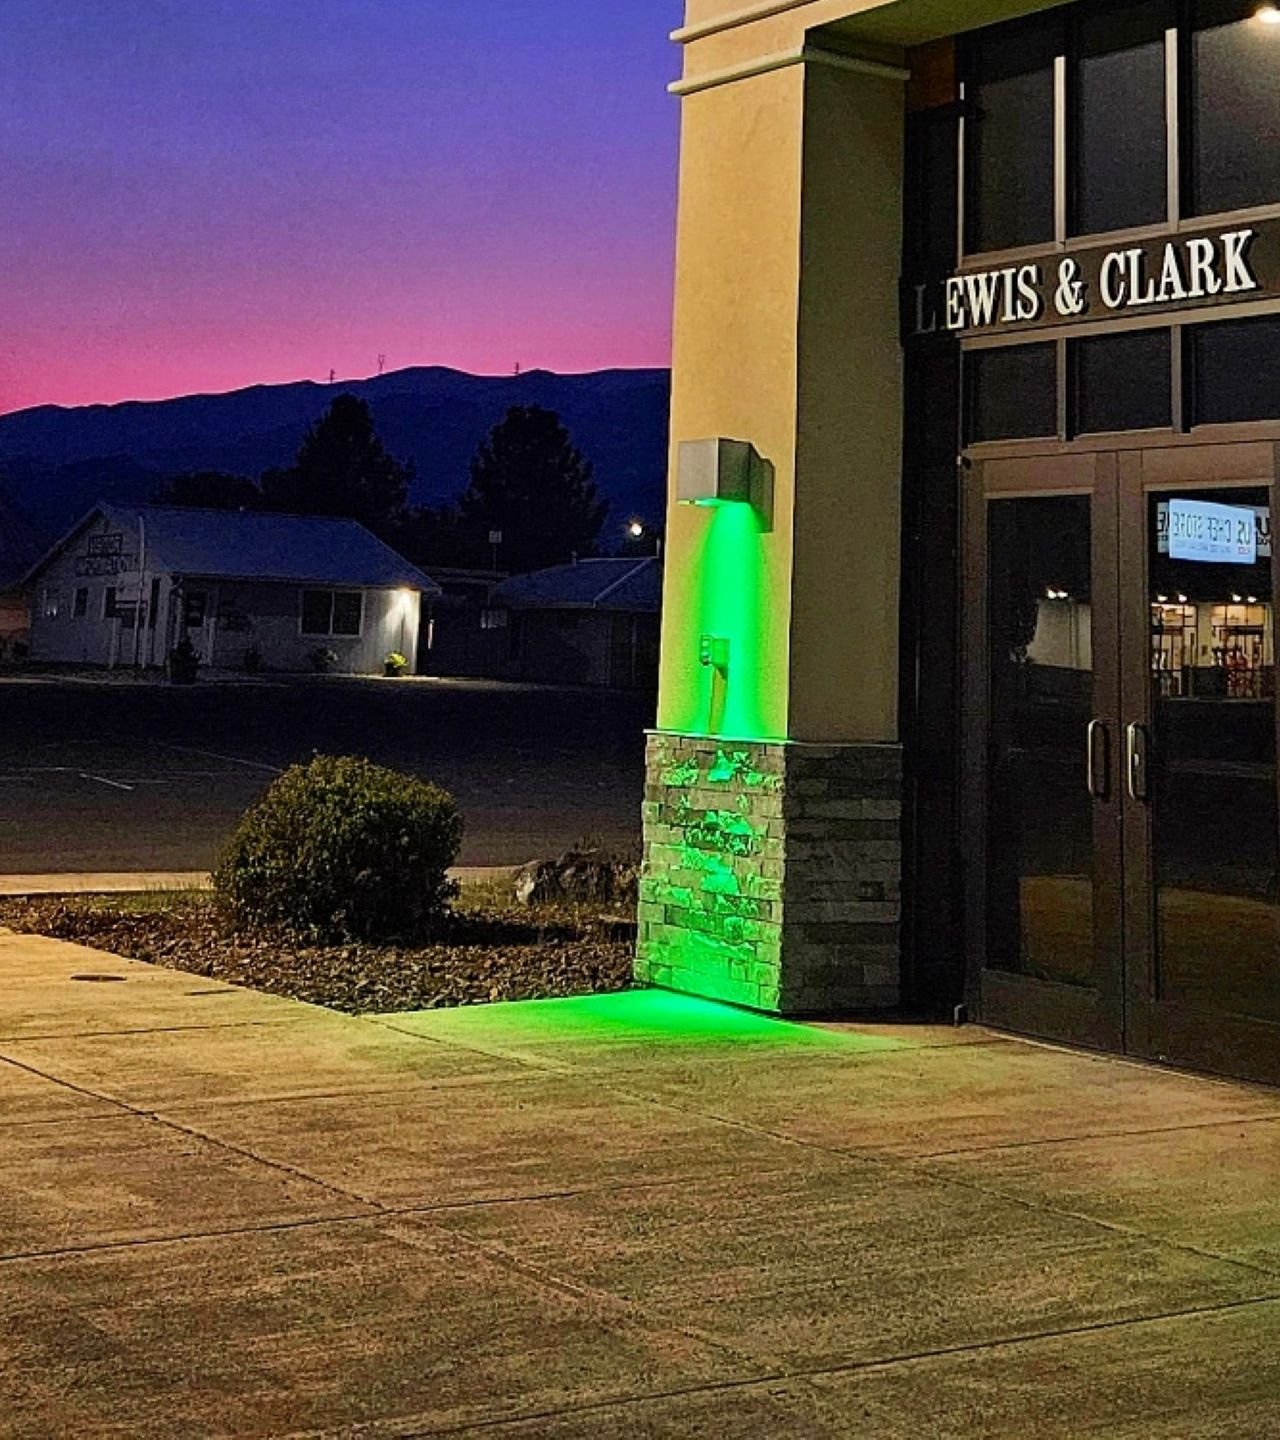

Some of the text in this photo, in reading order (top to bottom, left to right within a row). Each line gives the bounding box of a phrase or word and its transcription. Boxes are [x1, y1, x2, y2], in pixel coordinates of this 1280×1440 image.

[915, 265, 1040, 333] LEWIS
[1054, 258, 1084, 316] &
[1099, 229, 1256, 308] CLARK
